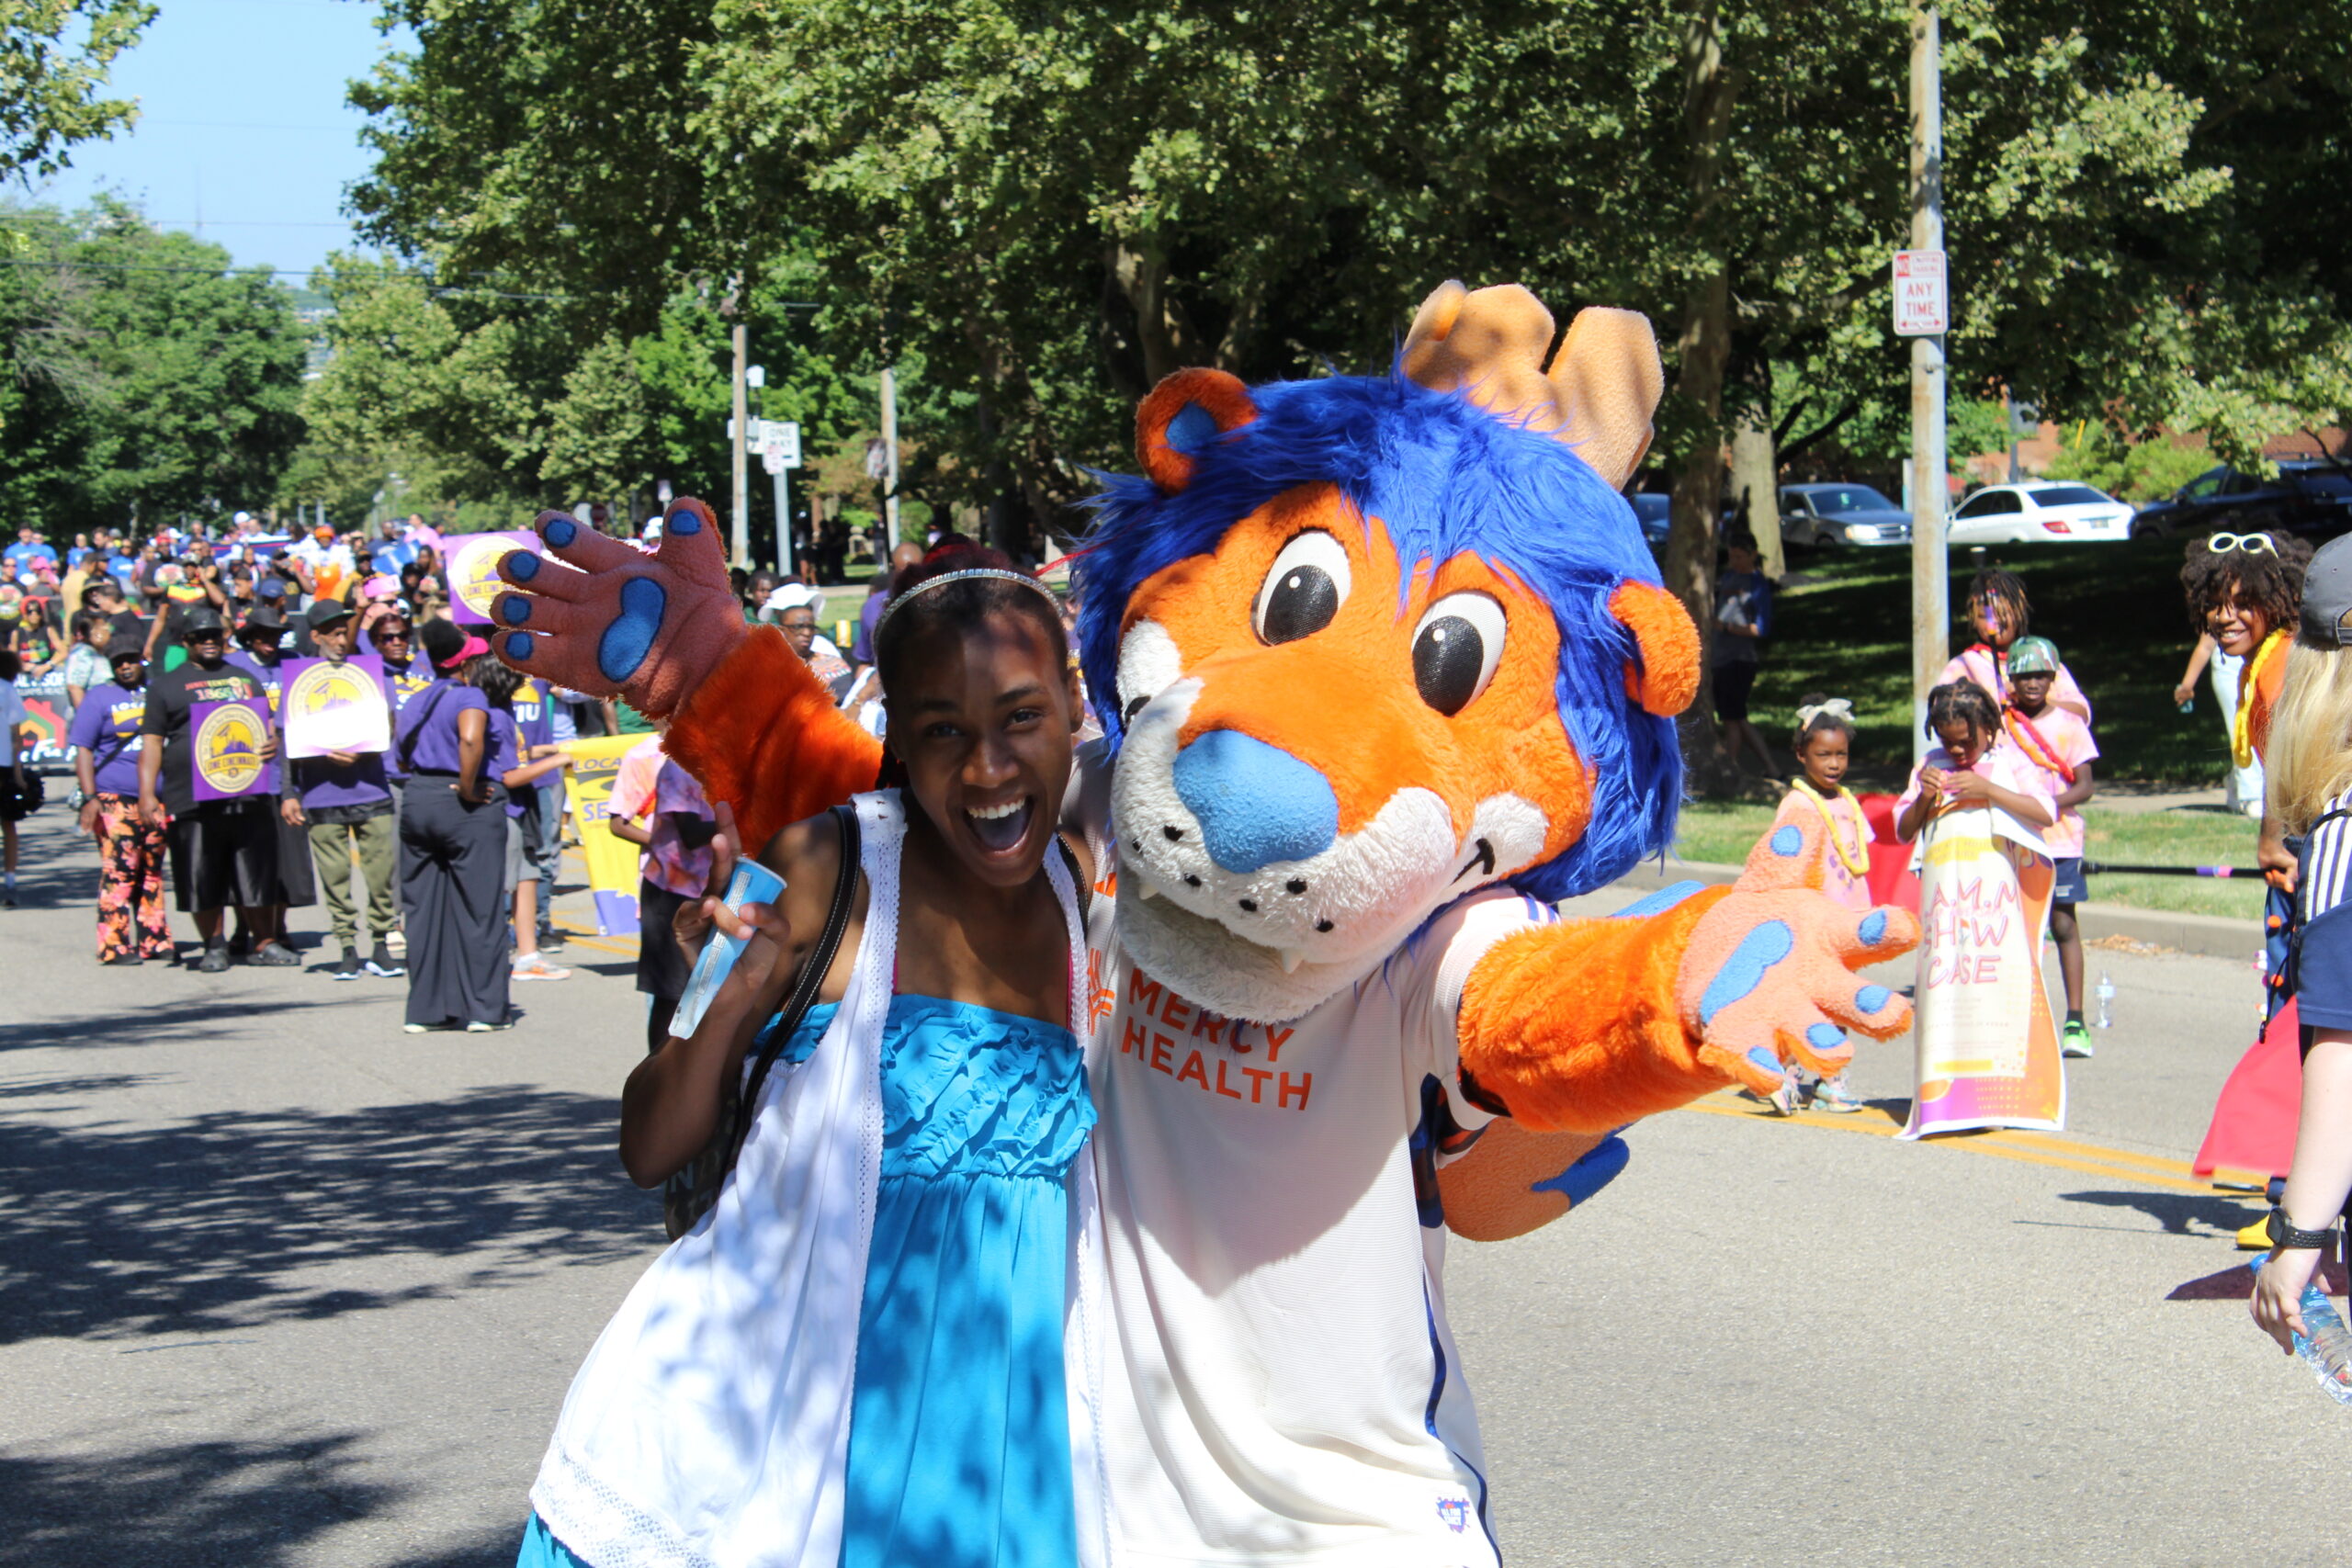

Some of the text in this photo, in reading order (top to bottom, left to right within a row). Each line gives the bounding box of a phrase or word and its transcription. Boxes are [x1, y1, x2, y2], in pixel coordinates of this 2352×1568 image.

[1906, 282, 1933, 297] ANY
[1905, 301, 1935, 317] TIME
[769, 427, 791, 437] ONE
[1926, 953, 2001, 990] CASE
[1128, 967, 1295, 1063] MERCY
[1121, 1015, 1312, 1111] HEALTH
